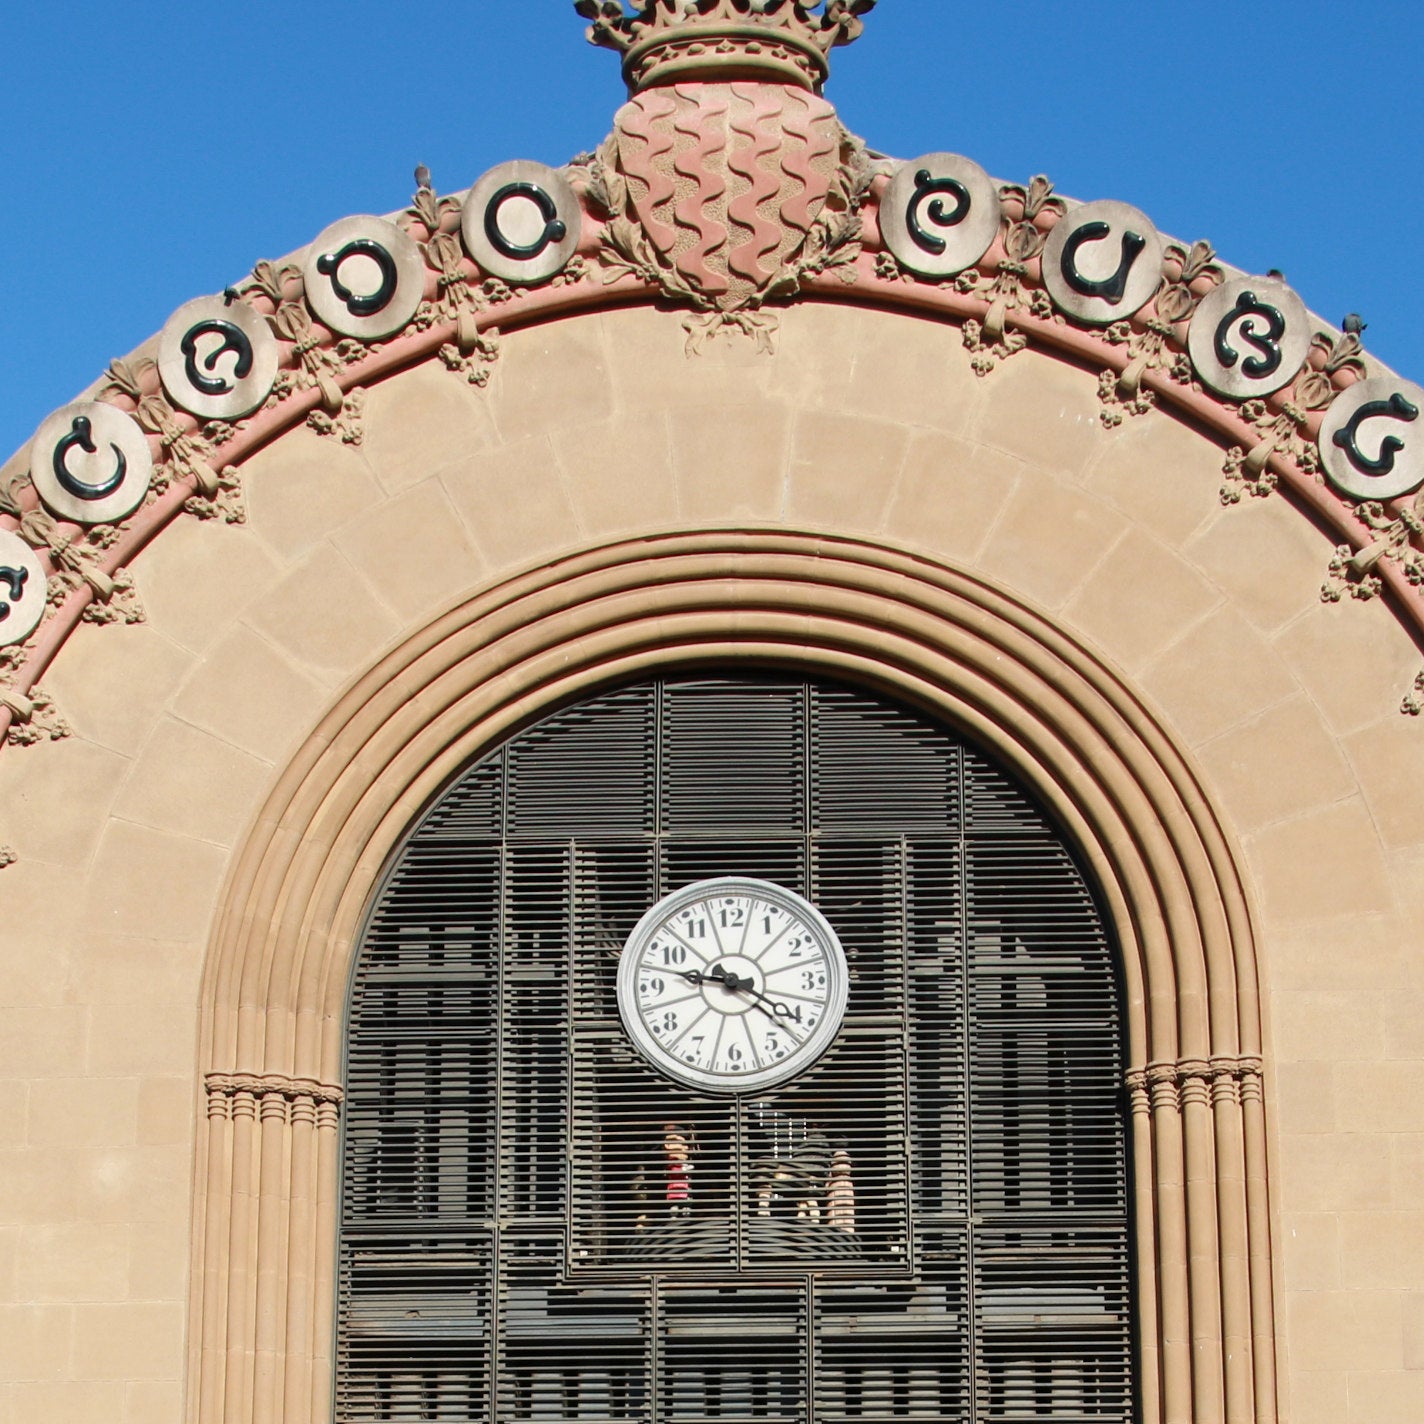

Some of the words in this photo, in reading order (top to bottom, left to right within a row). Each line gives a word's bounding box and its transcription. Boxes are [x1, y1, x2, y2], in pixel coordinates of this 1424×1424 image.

[718, 908, 744, 928] 12
[760, 916, 772, 935] 1
[687, 919, 706, 938] 11
[660, 946, 686, 965] 10
[788, 938, 802, 957] 2
[650, 978, 664, 996] 9
[801, 972, 814, 990] 3
[663, 1012, 678, 1030] 8
[790, 1004, 803, 1023] 4
[692, 1036, 705, 1054] 7
[764, 1032, 779, 1051] 5
[727, 1043, 742, 1061] 6
